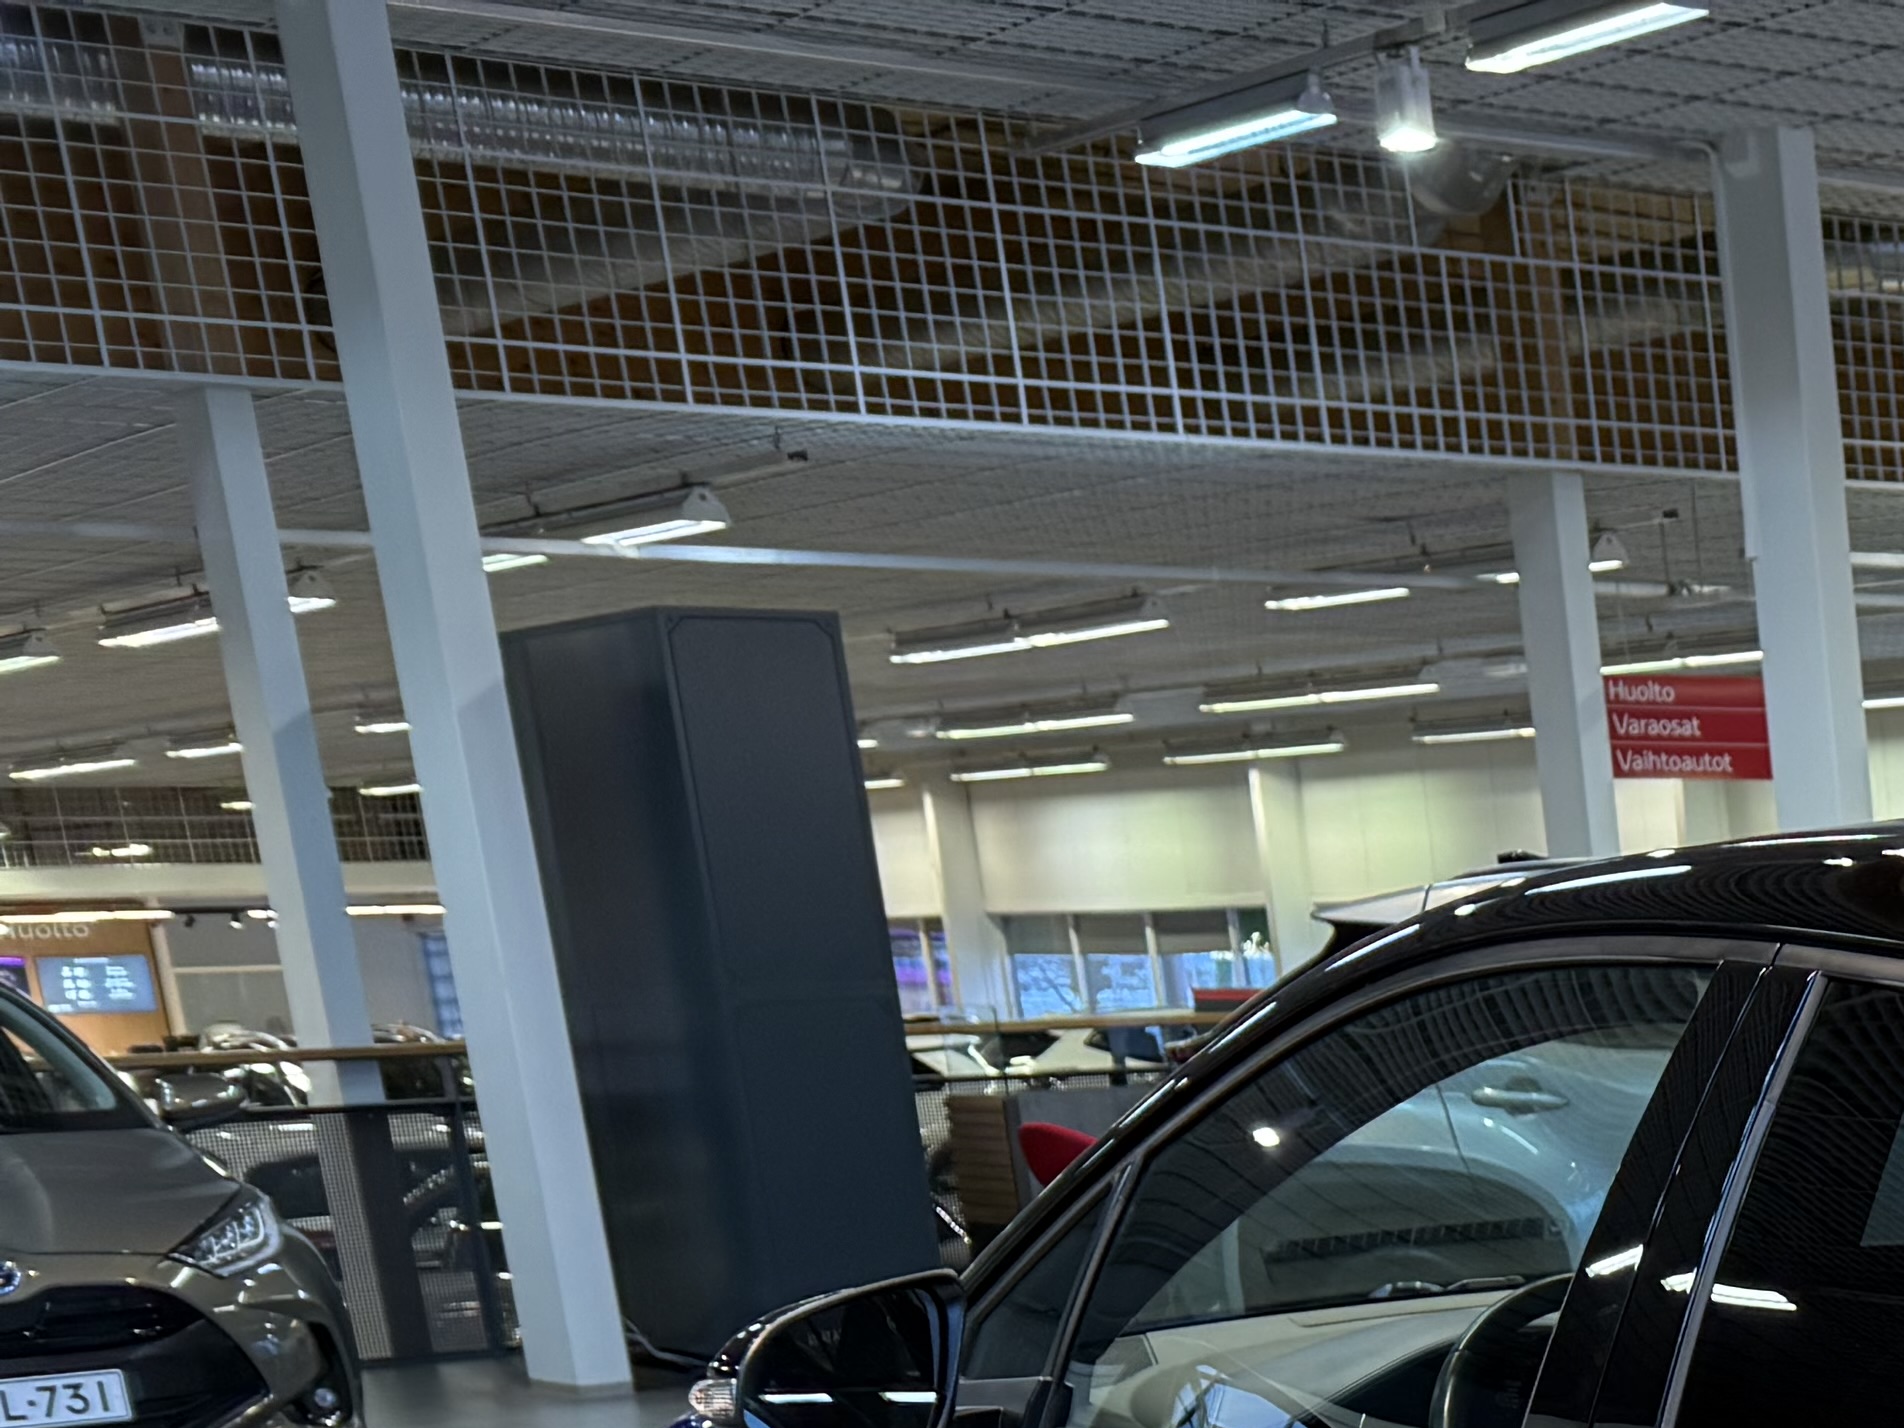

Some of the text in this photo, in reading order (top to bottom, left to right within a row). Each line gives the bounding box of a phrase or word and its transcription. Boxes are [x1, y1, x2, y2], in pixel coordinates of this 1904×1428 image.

[1608, 680, 1675, 703] Huolto
[1612, 713, 1702, 737] Varaosat
[1616, 749, 1734, 773] Vaihtoautot
